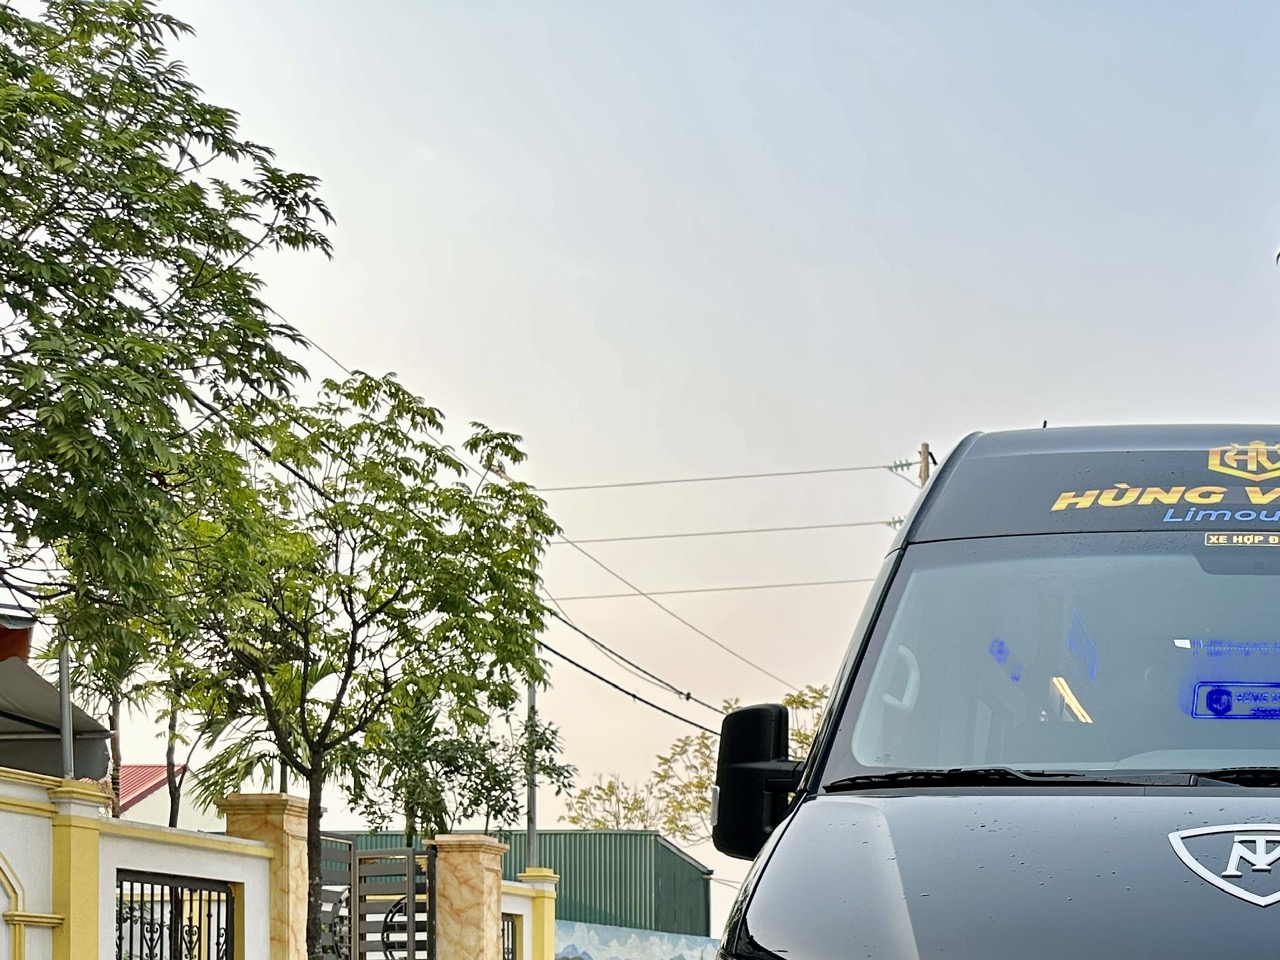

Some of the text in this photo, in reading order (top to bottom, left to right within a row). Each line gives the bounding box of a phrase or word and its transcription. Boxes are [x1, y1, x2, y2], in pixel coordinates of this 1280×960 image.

[1050, 482, 1228, 512] HÙNG
[1208, 535, 1228, 544] XE
[1233, 534, 1264, 546] HỢP
